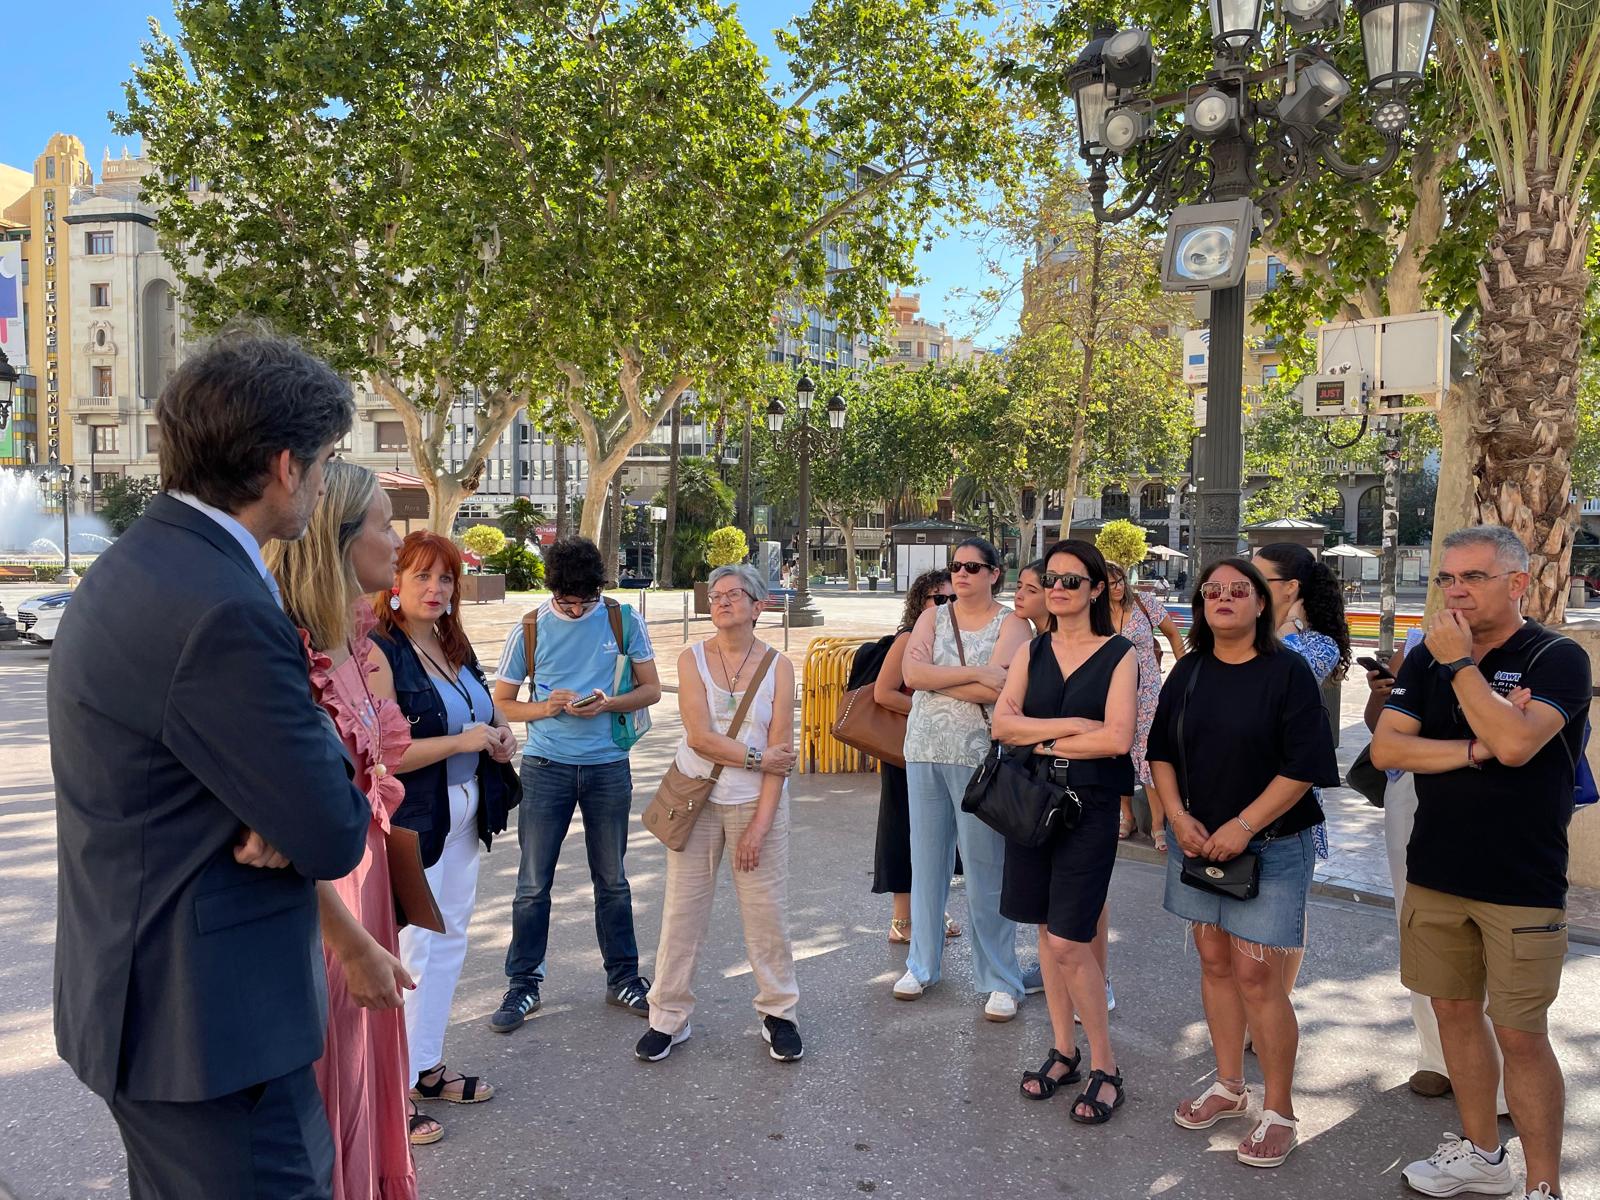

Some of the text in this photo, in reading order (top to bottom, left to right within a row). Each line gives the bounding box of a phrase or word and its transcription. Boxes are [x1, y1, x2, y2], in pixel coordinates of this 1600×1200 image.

[44, 201, 55, 267] RIALTO
[45, 281, 57, 346] TEATRE
[1319, 389, 1341, 398] JUST
[1501, 672, 1522, 682] BWT
[1489, 681, 1519, 689] LPIN
